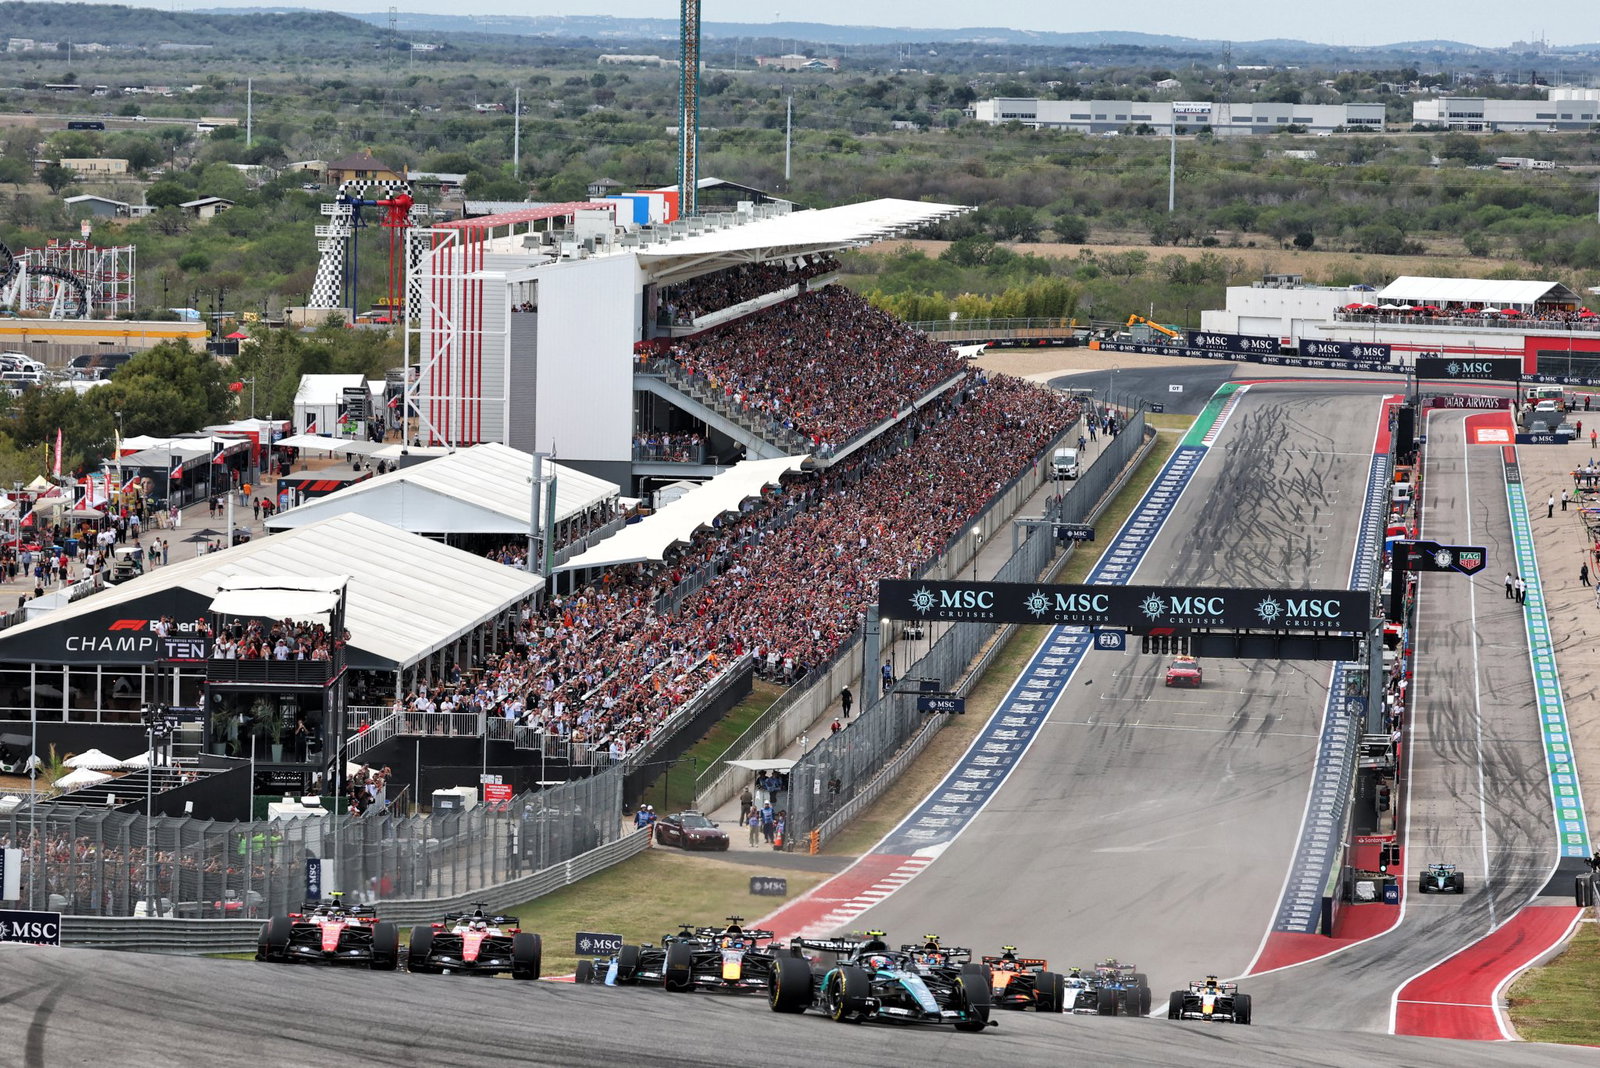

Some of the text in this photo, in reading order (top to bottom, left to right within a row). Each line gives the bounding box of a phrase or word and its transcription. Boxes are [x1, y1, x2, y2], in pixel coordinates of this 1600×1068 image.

[1206, 335, 1228, 345] MSC
[1251, 339, 1273, 349] MSC
[1318, 344, 1340, 354] MSC
[1363, 347, 1385, 357] MSC
[1462, 362, 1493, 373] MSC
[1444, 398, 1464, 408] QATAR
[1466, 398, 1499, 408] AIRWAYS
[940, 590, 994, 609] MSC
[1055, 593, 1109, 612] MSC
[1170, 596, 1225, 616] MSC
[1286, 598, 1341, 618] MSC
[1054, 614, 1109, 622] CRUISES
[1170, 617, 1225, 625] CRUISES
[1100, 634, 1120, 646] FIA
[164, 642, 204, 658] TEN
[308, 864, 316, 884] MSC
[763, 881, 786, 890] MSC
[11, 921, 57, 938] MSC
[593, 939, 620, 949] MSC
